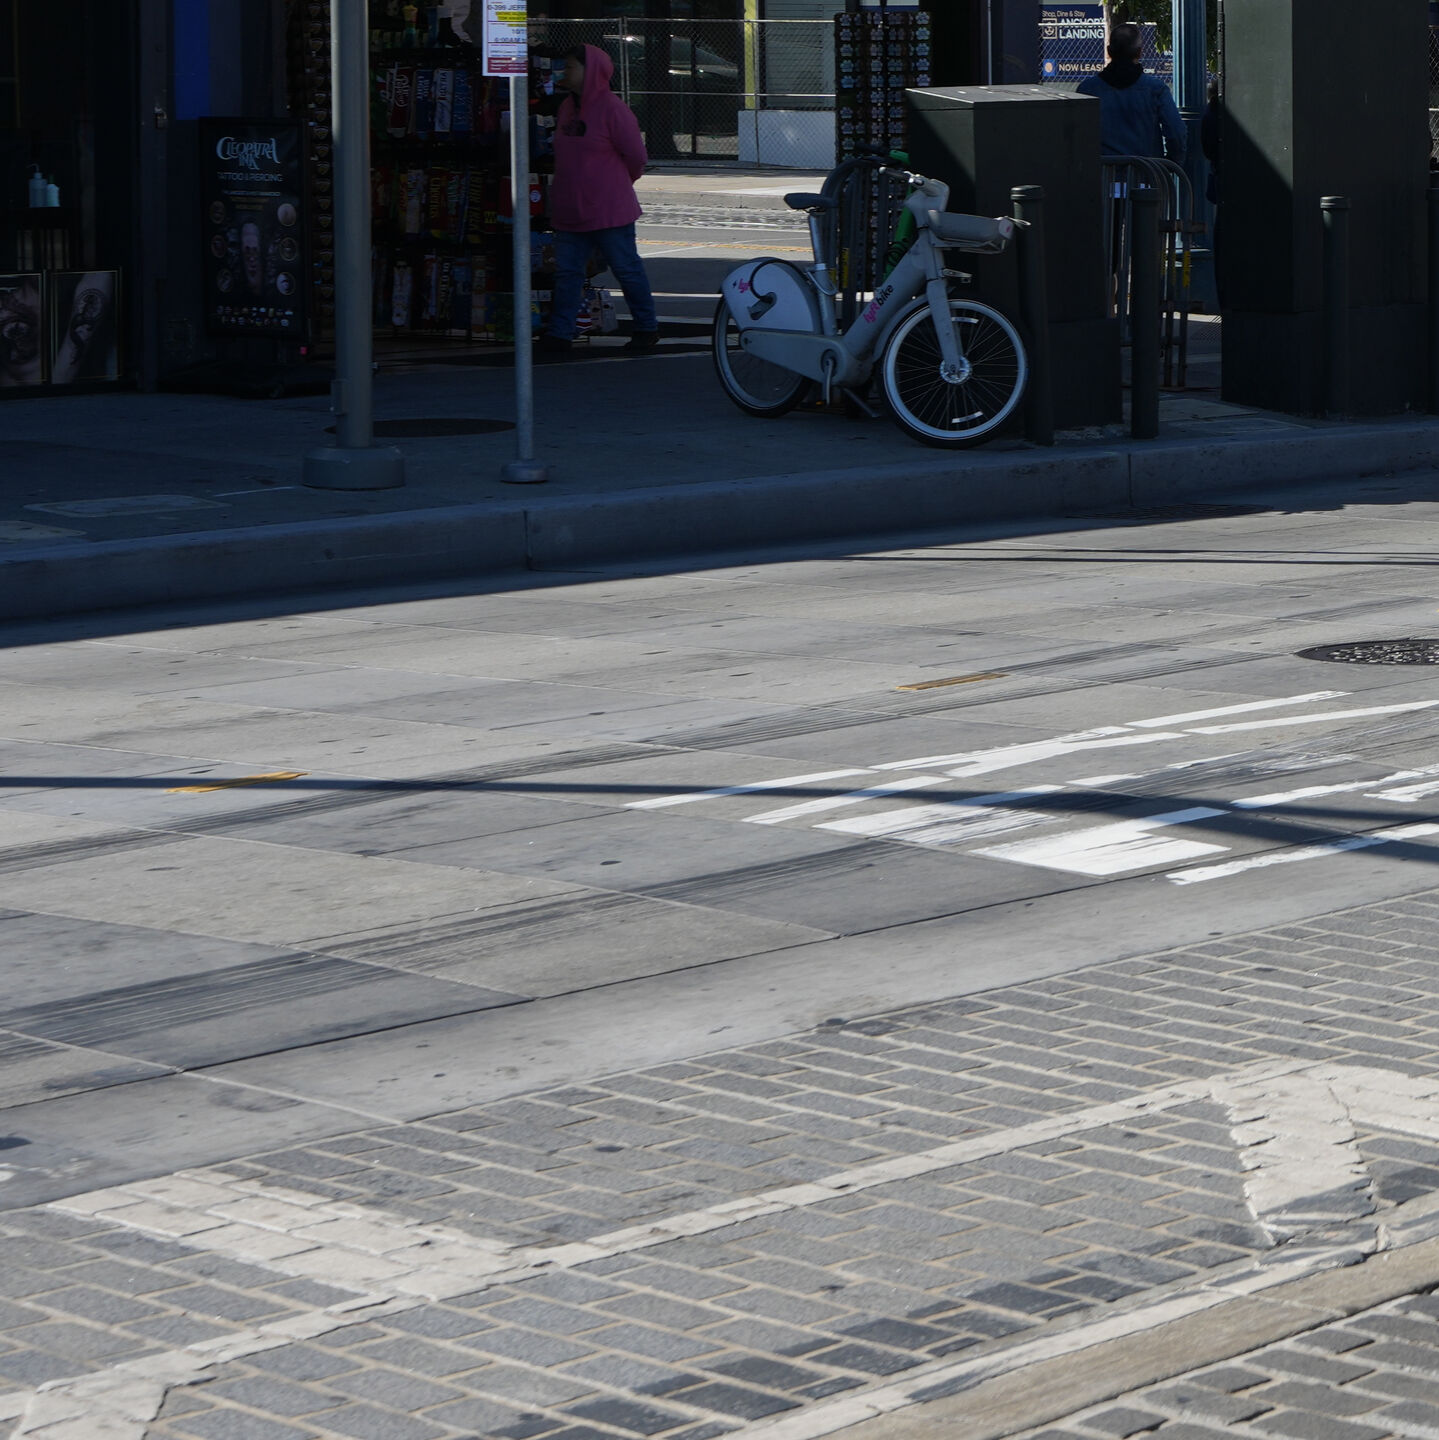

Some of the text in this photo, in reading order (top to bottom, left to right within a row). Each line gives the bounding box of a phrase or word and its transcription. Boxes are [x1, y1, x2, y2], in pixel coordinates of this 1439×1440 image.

[1072, 10, 1086, 19] Stay
[1059, 29, 1105, 40] LANDING
[1058, 63, 1104, 72] NOW LEASI
[216, 136, 281, 164] CLEOPATRA
